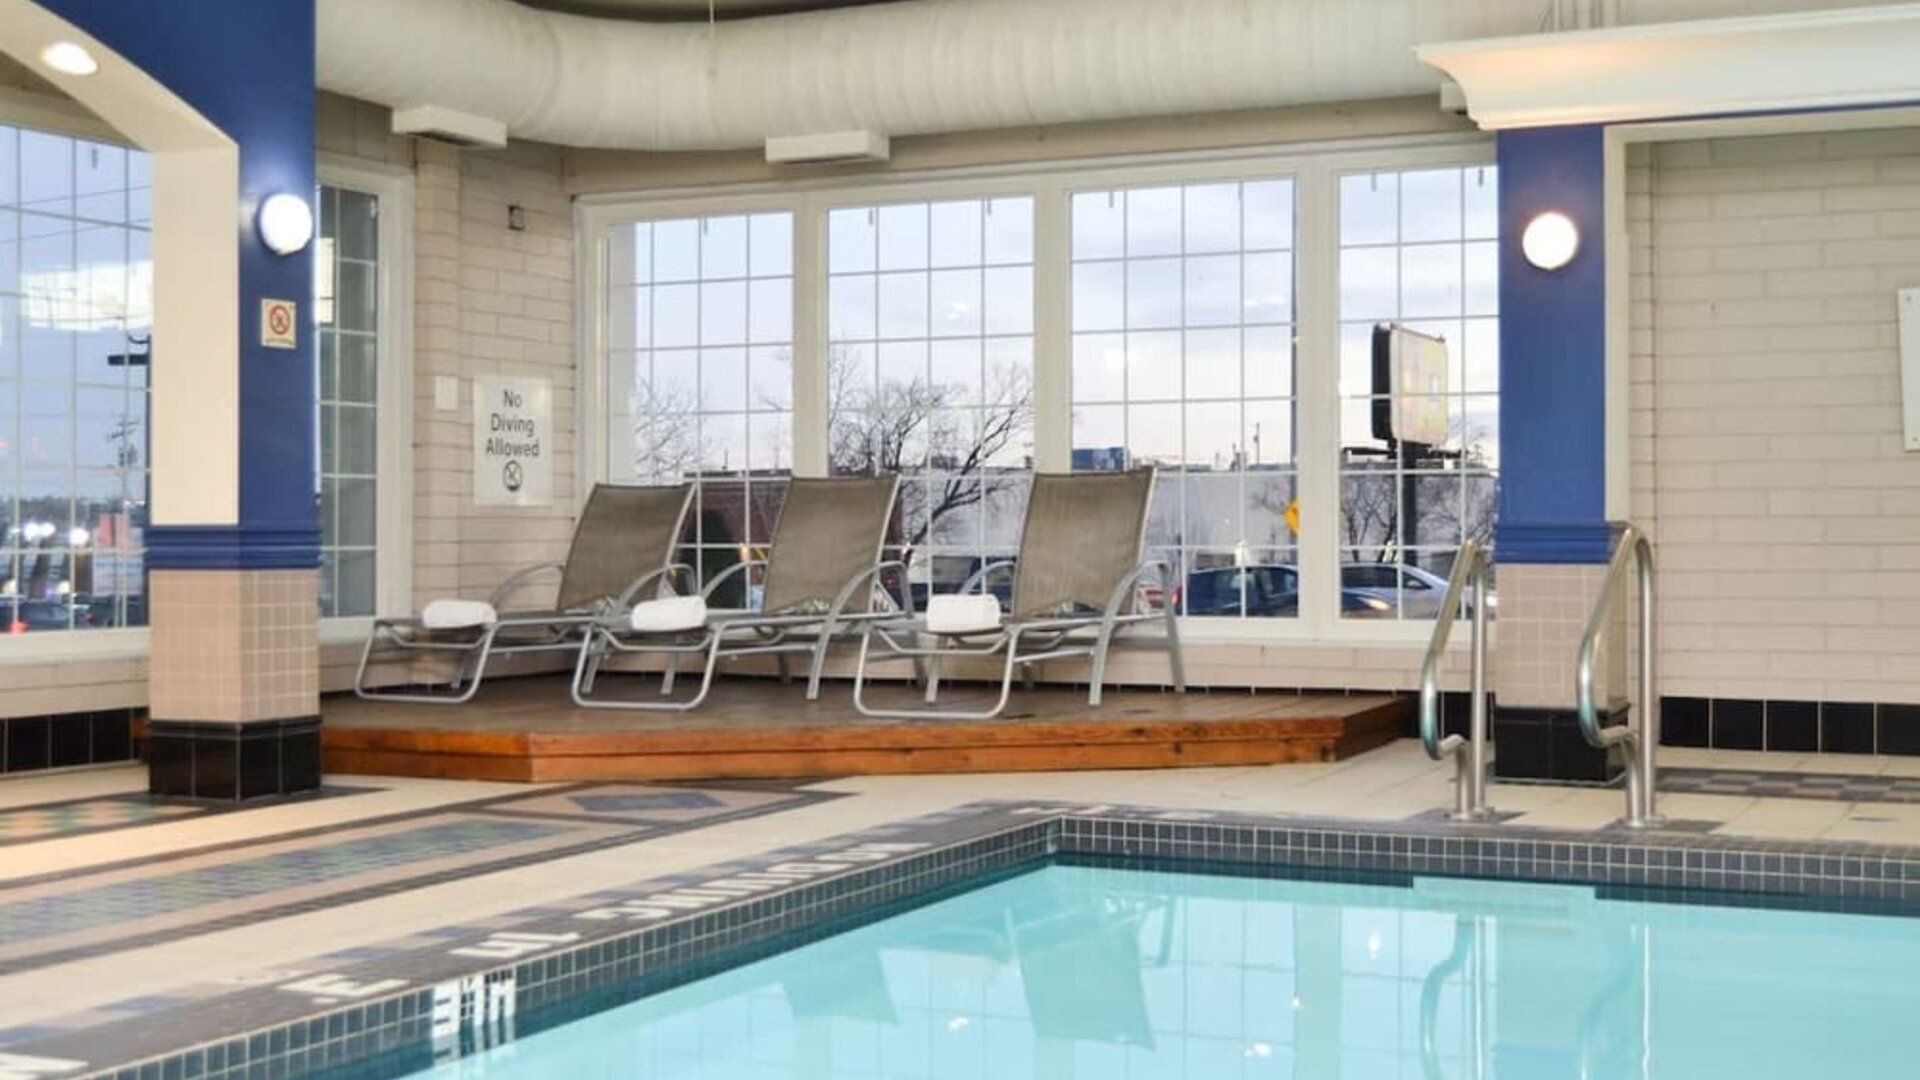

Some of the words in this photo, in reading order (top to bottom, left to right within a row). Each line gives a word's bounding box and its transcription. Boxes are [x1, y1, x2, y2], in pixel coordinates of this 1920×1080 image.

[503, 389, 523, 408] No
[490, 412, 535, 438] Diving
[485, 437, 540, 457] Allowed
